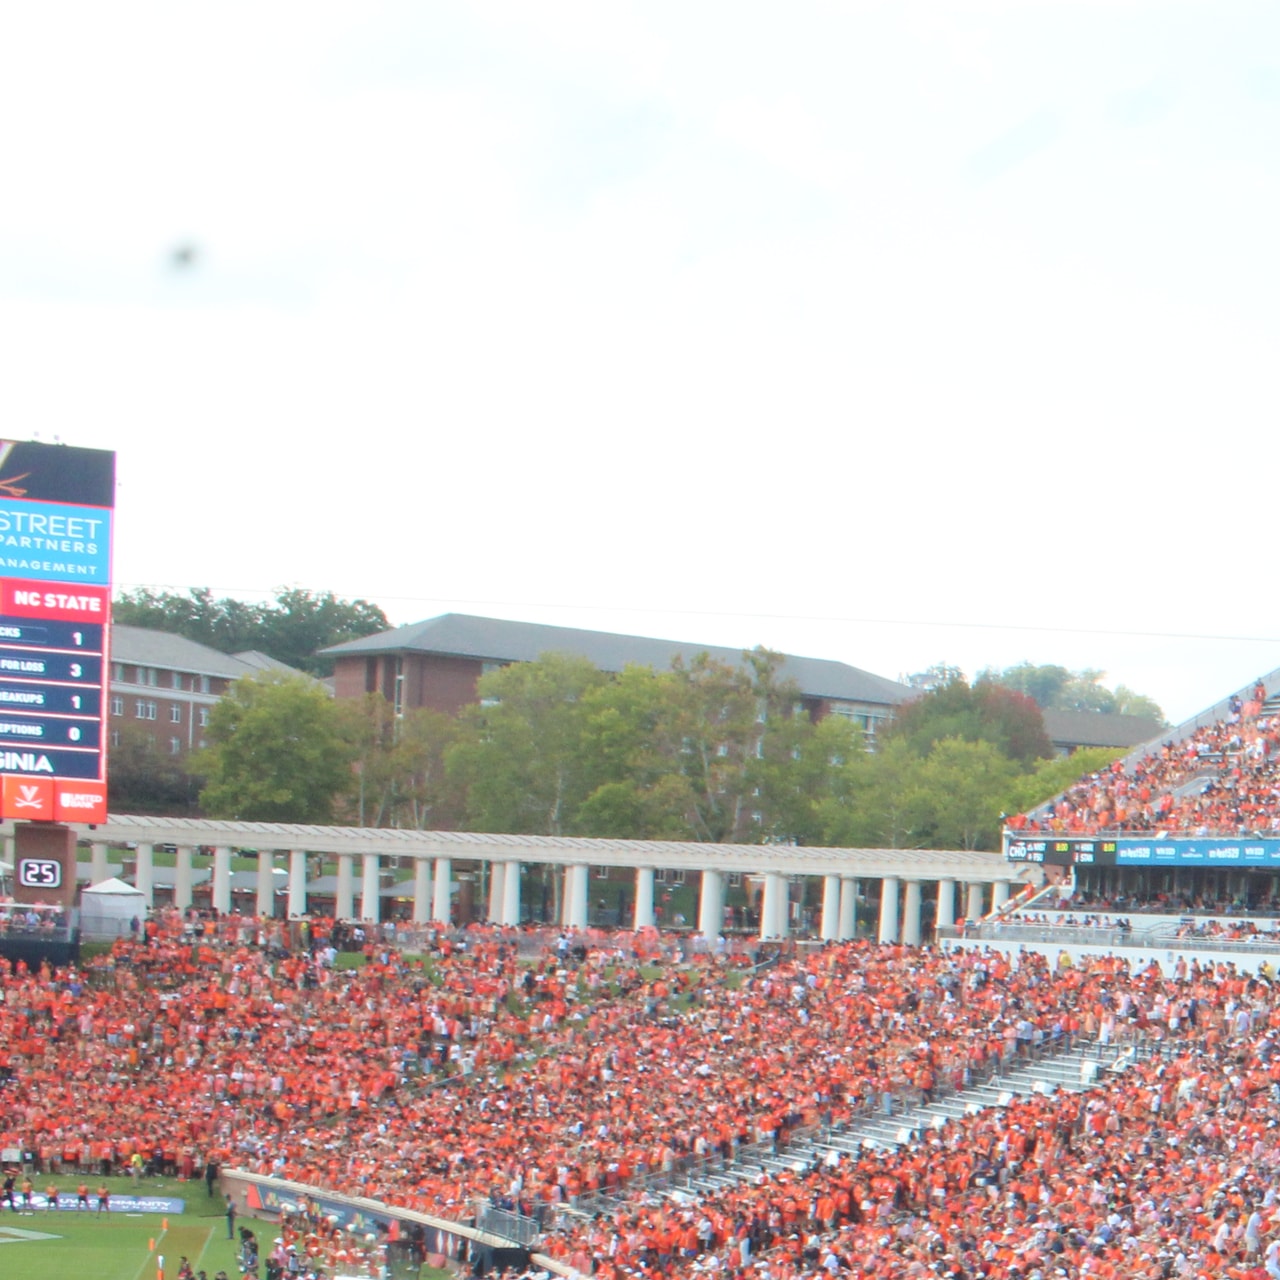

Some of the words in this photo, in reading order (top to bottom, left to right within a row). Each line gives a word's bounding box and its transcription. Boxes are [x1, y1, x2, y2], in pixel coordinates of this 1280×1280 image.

[0, 510, 103, 539] STREET
[14, 591, 41, 606] NC
[44, 594, 101, 612] STATE
[72, 632, 82, 645] 1
[21, 662, 45, 673] LOSS
[70, 664, 82, 677] 3
[71, 696, 81, 709] 1
[68, 727, 81, 741] 0
[26, 863, 55, 883] 25
